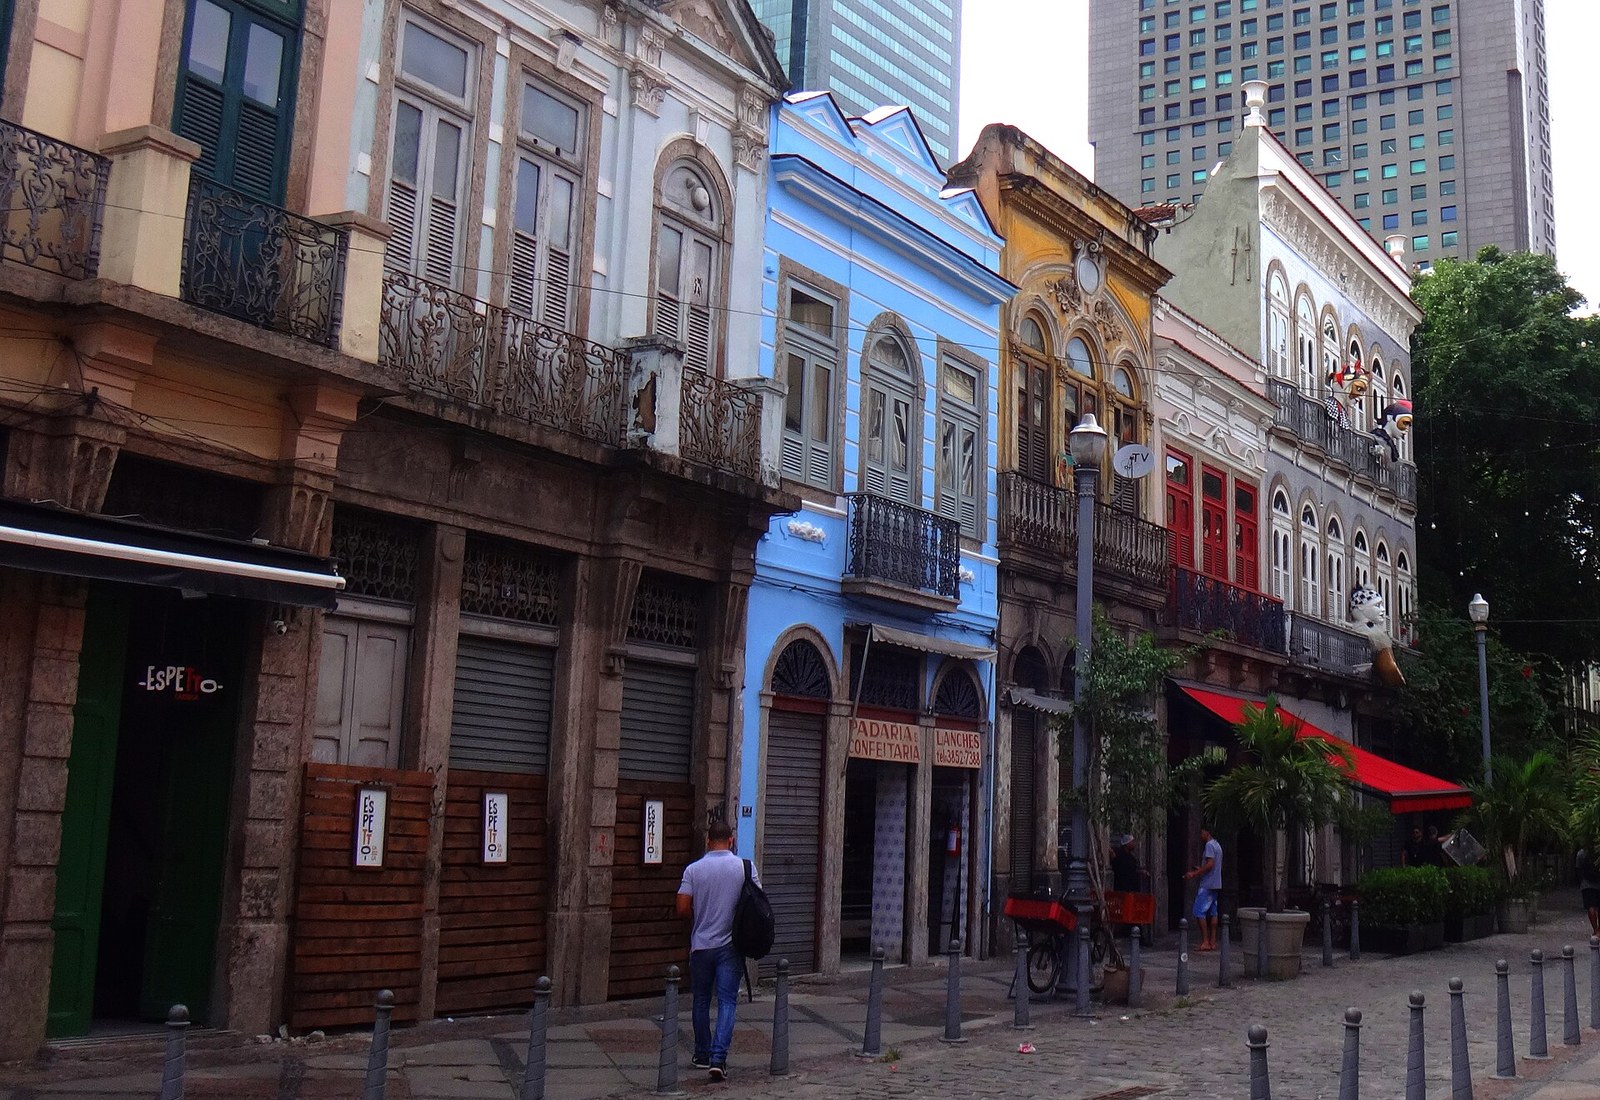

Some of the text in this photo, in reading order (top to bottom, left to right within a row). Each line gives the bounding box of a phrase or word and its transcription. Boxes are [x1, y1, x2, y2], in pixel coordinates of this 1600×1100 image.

[1132, 453, 1149, 462] TV
[849, 719, 912, 742] PADARIA
[936, 731, 980, 749] LANCHES
[849, 739, 920, 760] CONFEITARIA
